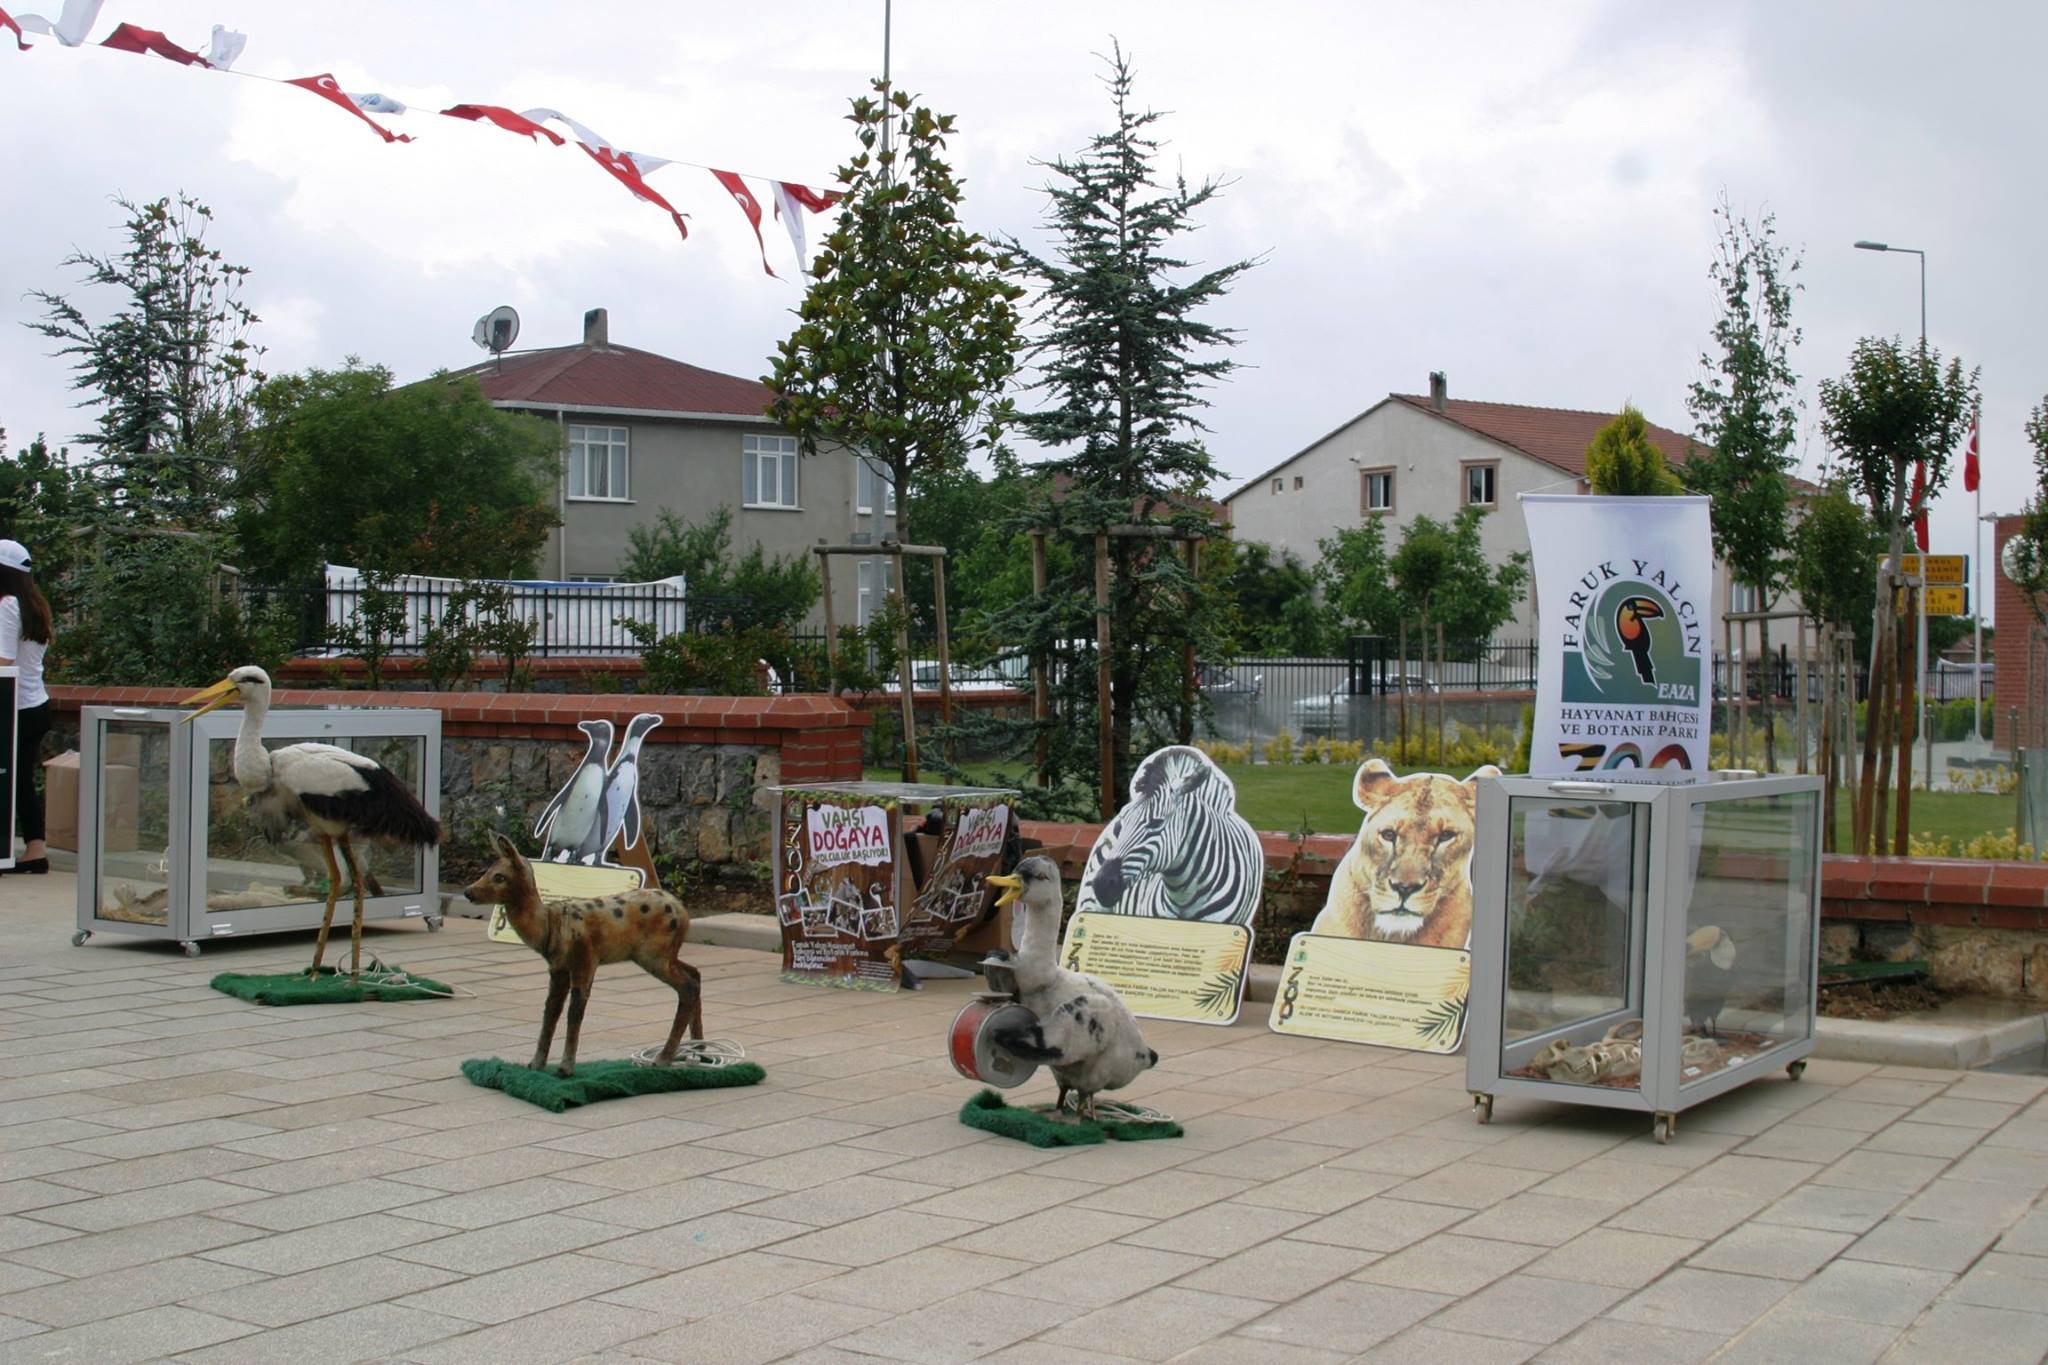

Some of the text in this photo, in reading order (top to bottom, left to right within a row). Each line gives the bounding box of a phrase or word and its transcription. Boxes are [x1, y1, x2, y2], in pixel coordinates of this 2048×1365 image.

[1563, 559, 1701, 653] FARUK YALÇIN
[1657, 683, 1695, 700] EAZA
[1561, 708, 1645, 721] HAYVANAT
[1560, 723, 1581, 735] VE
[1659, 725, 1698, 739] PARKI
[812, 822, 884, 852] DOĞAYA
[1279, 966, 1303, 1019] ZOO
